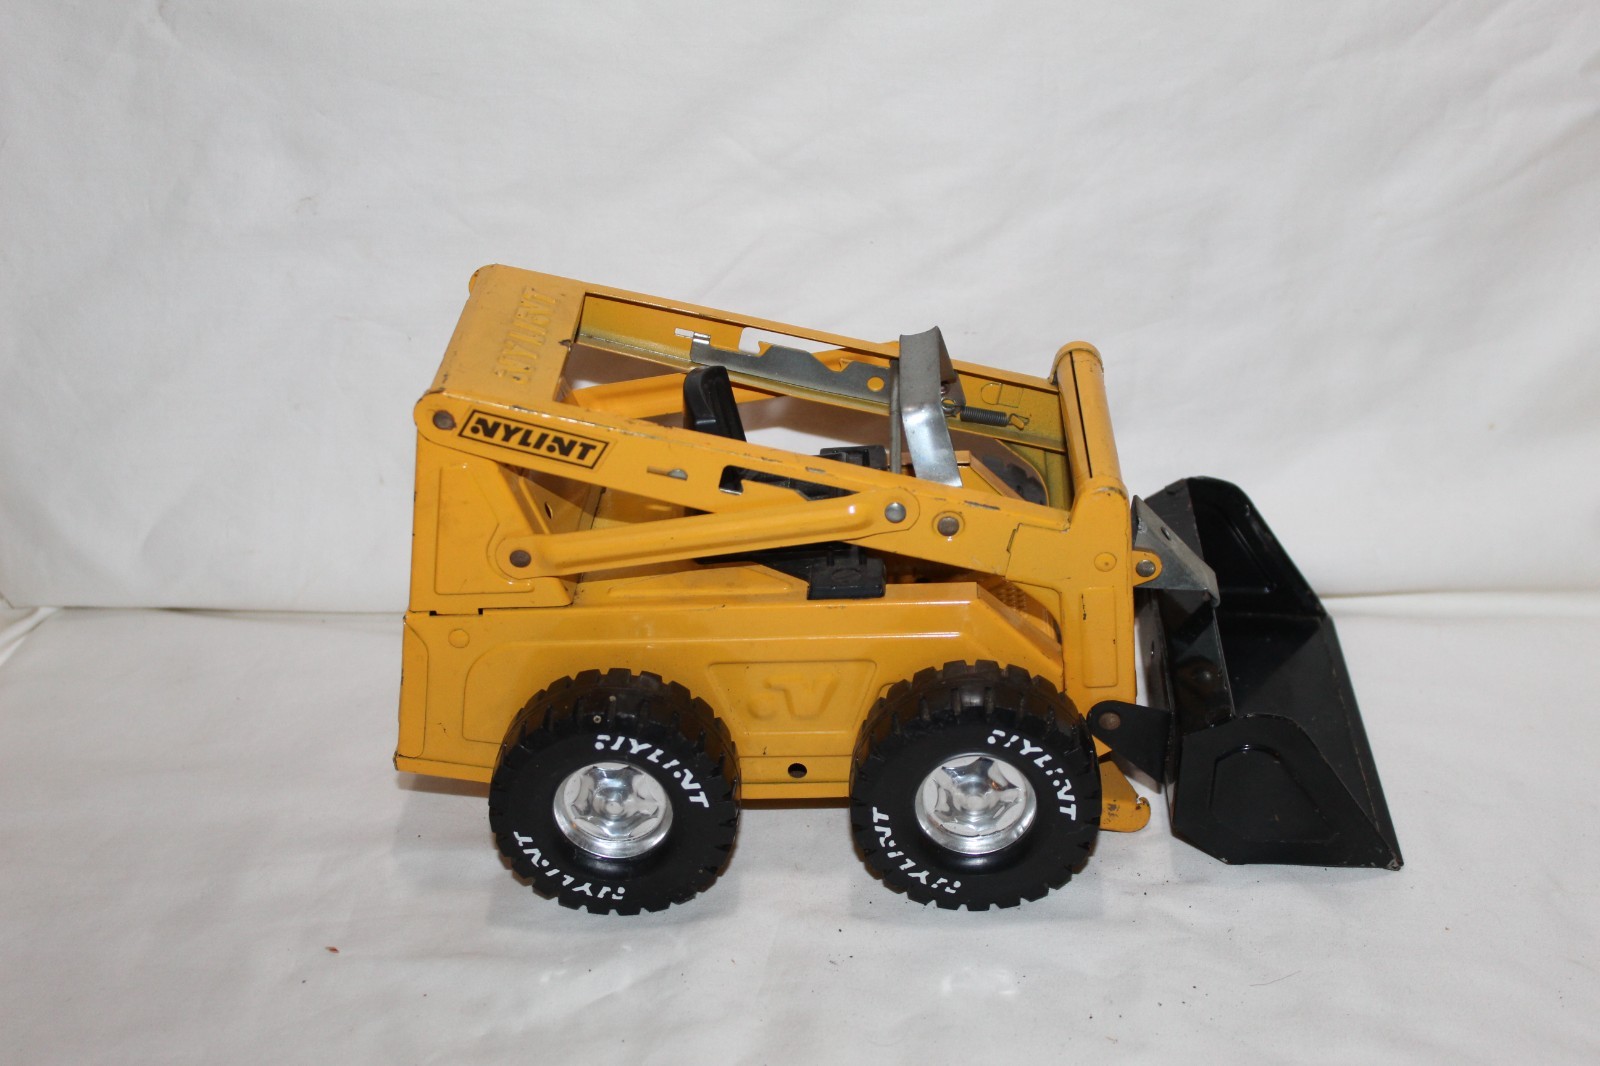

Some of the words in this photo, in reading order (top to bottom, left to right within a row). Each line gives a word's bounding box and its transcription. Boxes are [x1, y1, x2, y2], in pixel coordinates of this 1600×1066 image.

[497, 287, 555, 384] NYLINT
[470, 415, 597, 461] NYLINT
[595, 734, 710, 809] NYLINT
[986, 729, 1077, 821] NYLINT
[513, 831, 626, 900] NYLINT
[872, 806, 961, 893] NYLINT
